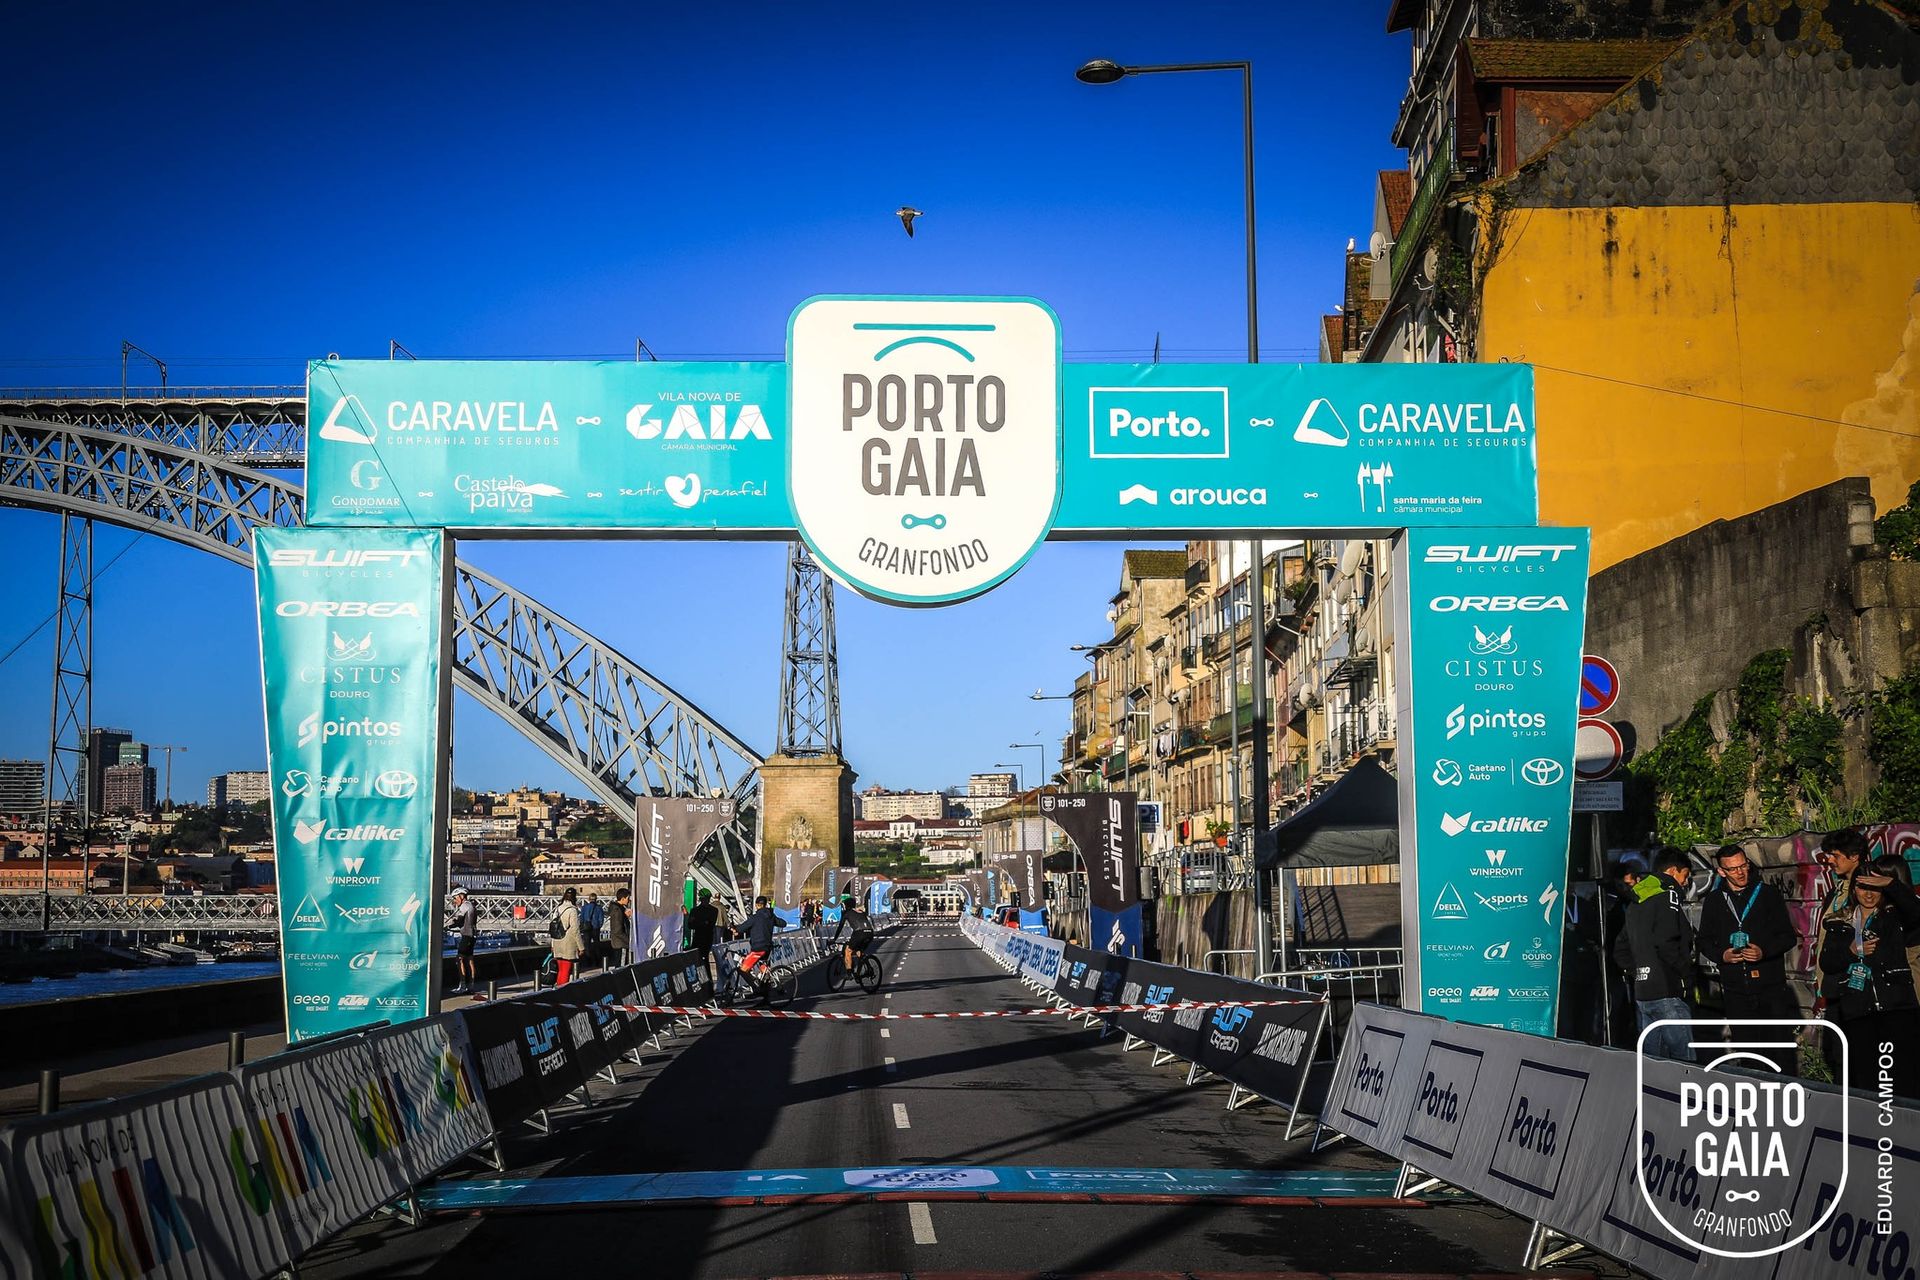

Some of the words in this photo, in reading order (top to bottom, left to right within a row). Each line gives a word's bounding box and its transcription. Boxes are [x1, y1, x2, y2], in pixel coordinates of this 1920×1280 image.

[658, 392, 685, 402] VILA
[688, 392, 721, 402] NOVA
[724, 392, 741, 402] DE
[843, 373, 1005, 432] PORTO
[388, 401, 559, 432] CARAVELA
[625, 404, 773, 440] GAIA
[1110, 408, 1210, 438] Porto.
[1358, 403, 1526, 433] CARAVELA
[388, 436, 466, 446] COMPANHIA
[475, 437, 491, 446] DE
[498, 437, 559, 446] SEGUROS
[1359, 438, 1436, 447] COMPANHIA
[1444, 438, 1460, 447] DE
[1467, 438, 1528, 447] SEGUROS
[862, 438, 986, 496] GAIA
[454, 474, 525, 494] Castelo
[619, 485, 664, 497] sentir
[702, 481, 768, 501] penafiel
[471, 492, 534, 513] paiva
[1170, 486, 1267, 505] arouca
[1460, 496, 1482, 504] feira
[1424, 505, 1462, 515] municipal
[269, 550, 427, 567] SWIFT
[859, 537, 988, 575] GRANFONDO
[1424, 545, 1576, 562] SWIFT
[303, 570, 393, 578] BICYCLES
[275, 600, 420, 618] ORBEA
[1429, 595, 1569, 612] ORBEA
[300, 667, 401, 684] CISTUS
[1445, 660, 1543, 676] CISTUS
[322, 717, 401, 743] pintos
[1470, 709, 1546, 736] pintos
[1468, 764, 1506, 772] Caetano
[686, 803, 714, 813] 101-250
[1057, 798, 1086, 808] 101-250
[324, 825, 405, 841] catlike
[1470, 817, 1548, 833] catlike
[649, 803, 664, 908] SWIFT
[1109, 798, 1125, 902] SWIFT
[325, 876, 381, 884] WINPROVIT
[1026, 854, 1035, 906] ORBEA
[1470, 868, 1524, 876] WINPROVIT
[296, 915, 320, 923] DELTA
[1522, 953, 1552, 961] DOURO
[337, 994, 370, 1006] KTM
[1470, 986, 1500, 997] KTM
[1507, 989, 1550, 997] VOUGA
[375, 997, 419, 1006] VOUGA
[525, 1016, 562, 1057] SWIFT
[1355, 1052, 1384, 1097] Porto.
[1416, 1071, 1458, 1124] Porto.
[1507, 1096, 1556, 1158] Porto.
[1630, 1130, 1701, 1212] Porto.
